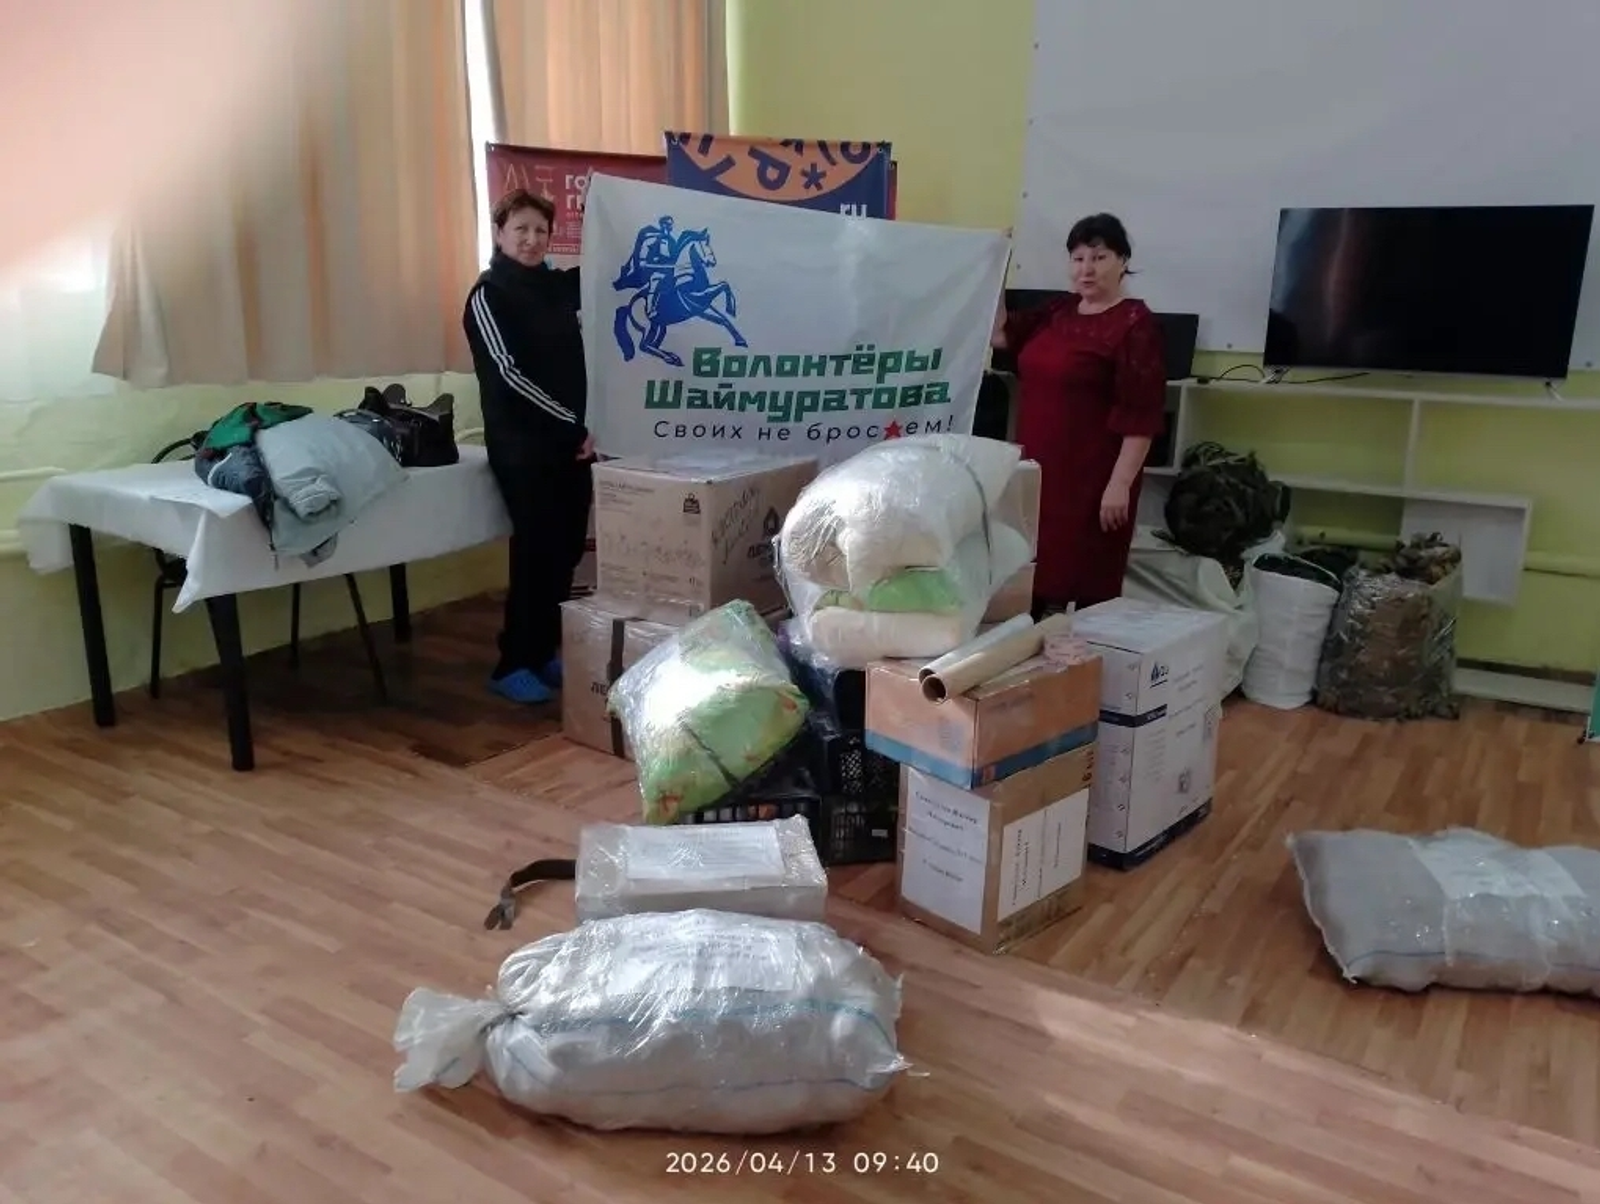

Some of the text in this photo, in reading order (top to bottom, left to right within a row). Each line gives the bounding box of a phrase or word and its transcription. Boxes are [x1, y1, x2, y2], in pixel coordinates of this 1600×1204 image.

[692, 344, 943, 384] Волонтёры
[644, 379, 951, 424] Шаймуратова
[653, 414, 954, 445] Своих не бросем!
